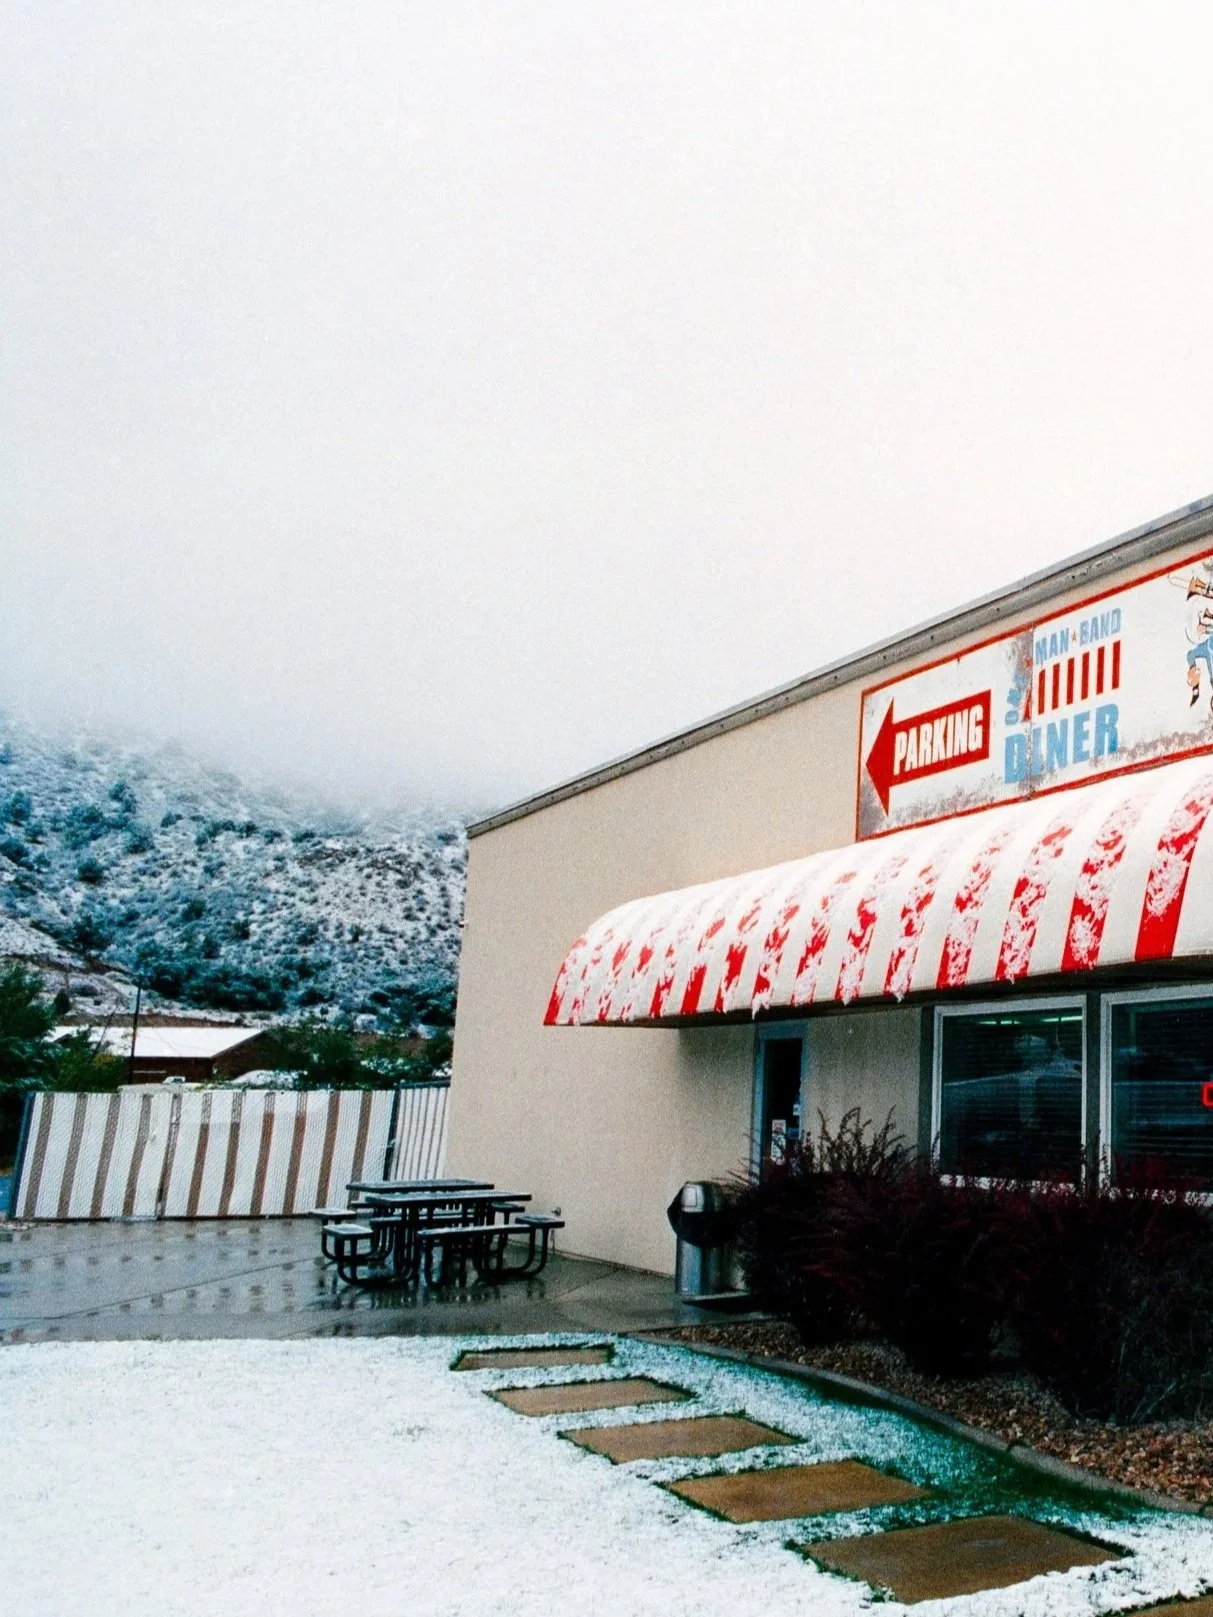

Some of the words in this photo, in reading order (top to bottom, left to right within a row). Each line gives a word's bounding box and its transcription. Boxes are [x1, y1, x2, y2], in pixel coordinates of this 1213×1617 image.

[1035, 627, 1070, 665] MAN
[893, 703, 984, 776] PARKING
[1004, 703, 1120, 784] DINER
